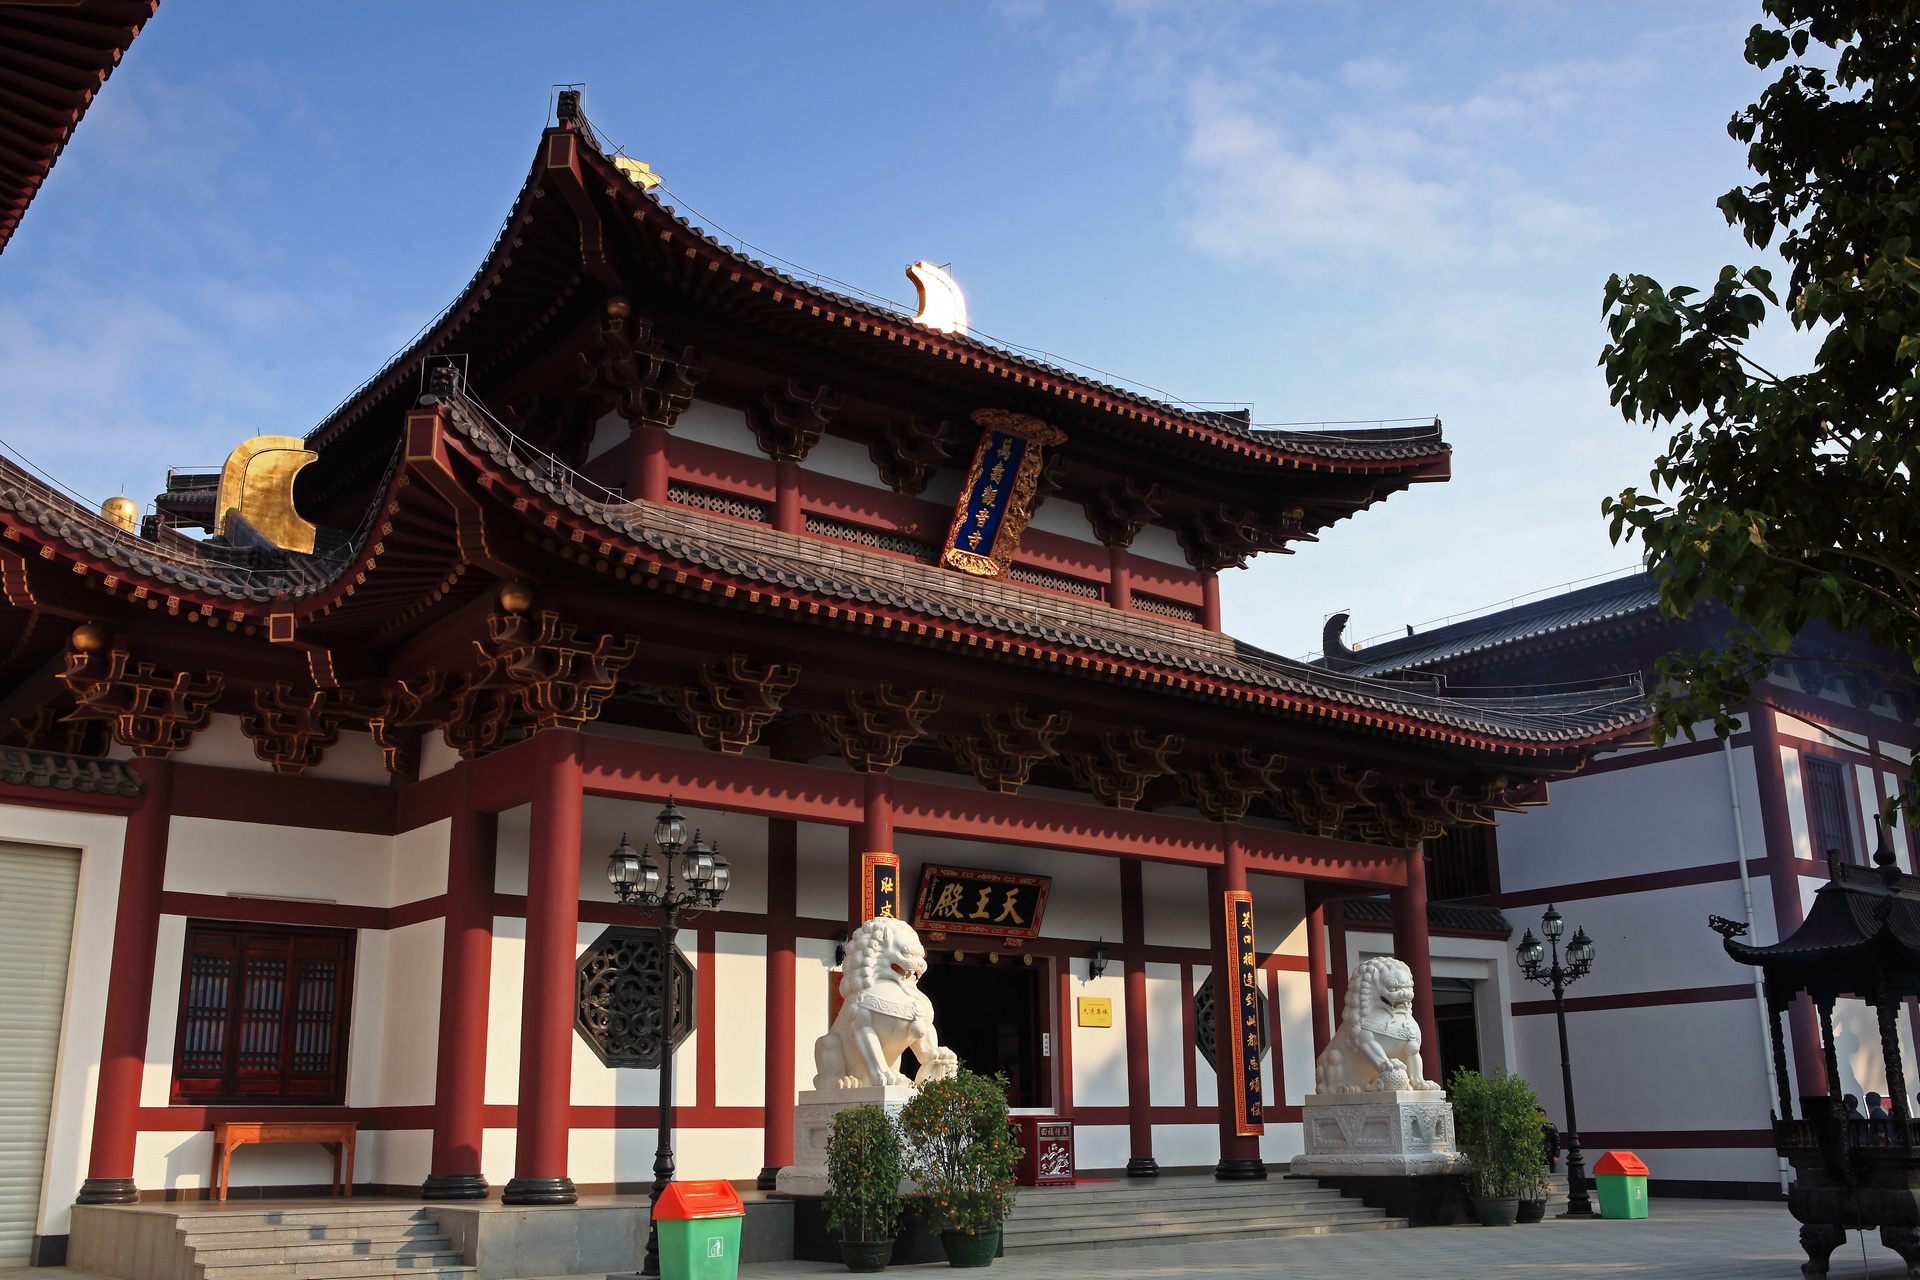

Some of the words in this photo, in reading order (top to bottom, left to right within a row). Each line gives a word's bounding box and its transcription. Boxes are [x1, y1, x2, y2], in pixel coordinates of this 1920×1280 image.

[967, 438, 1013, 551] 萬壽觀音寺
